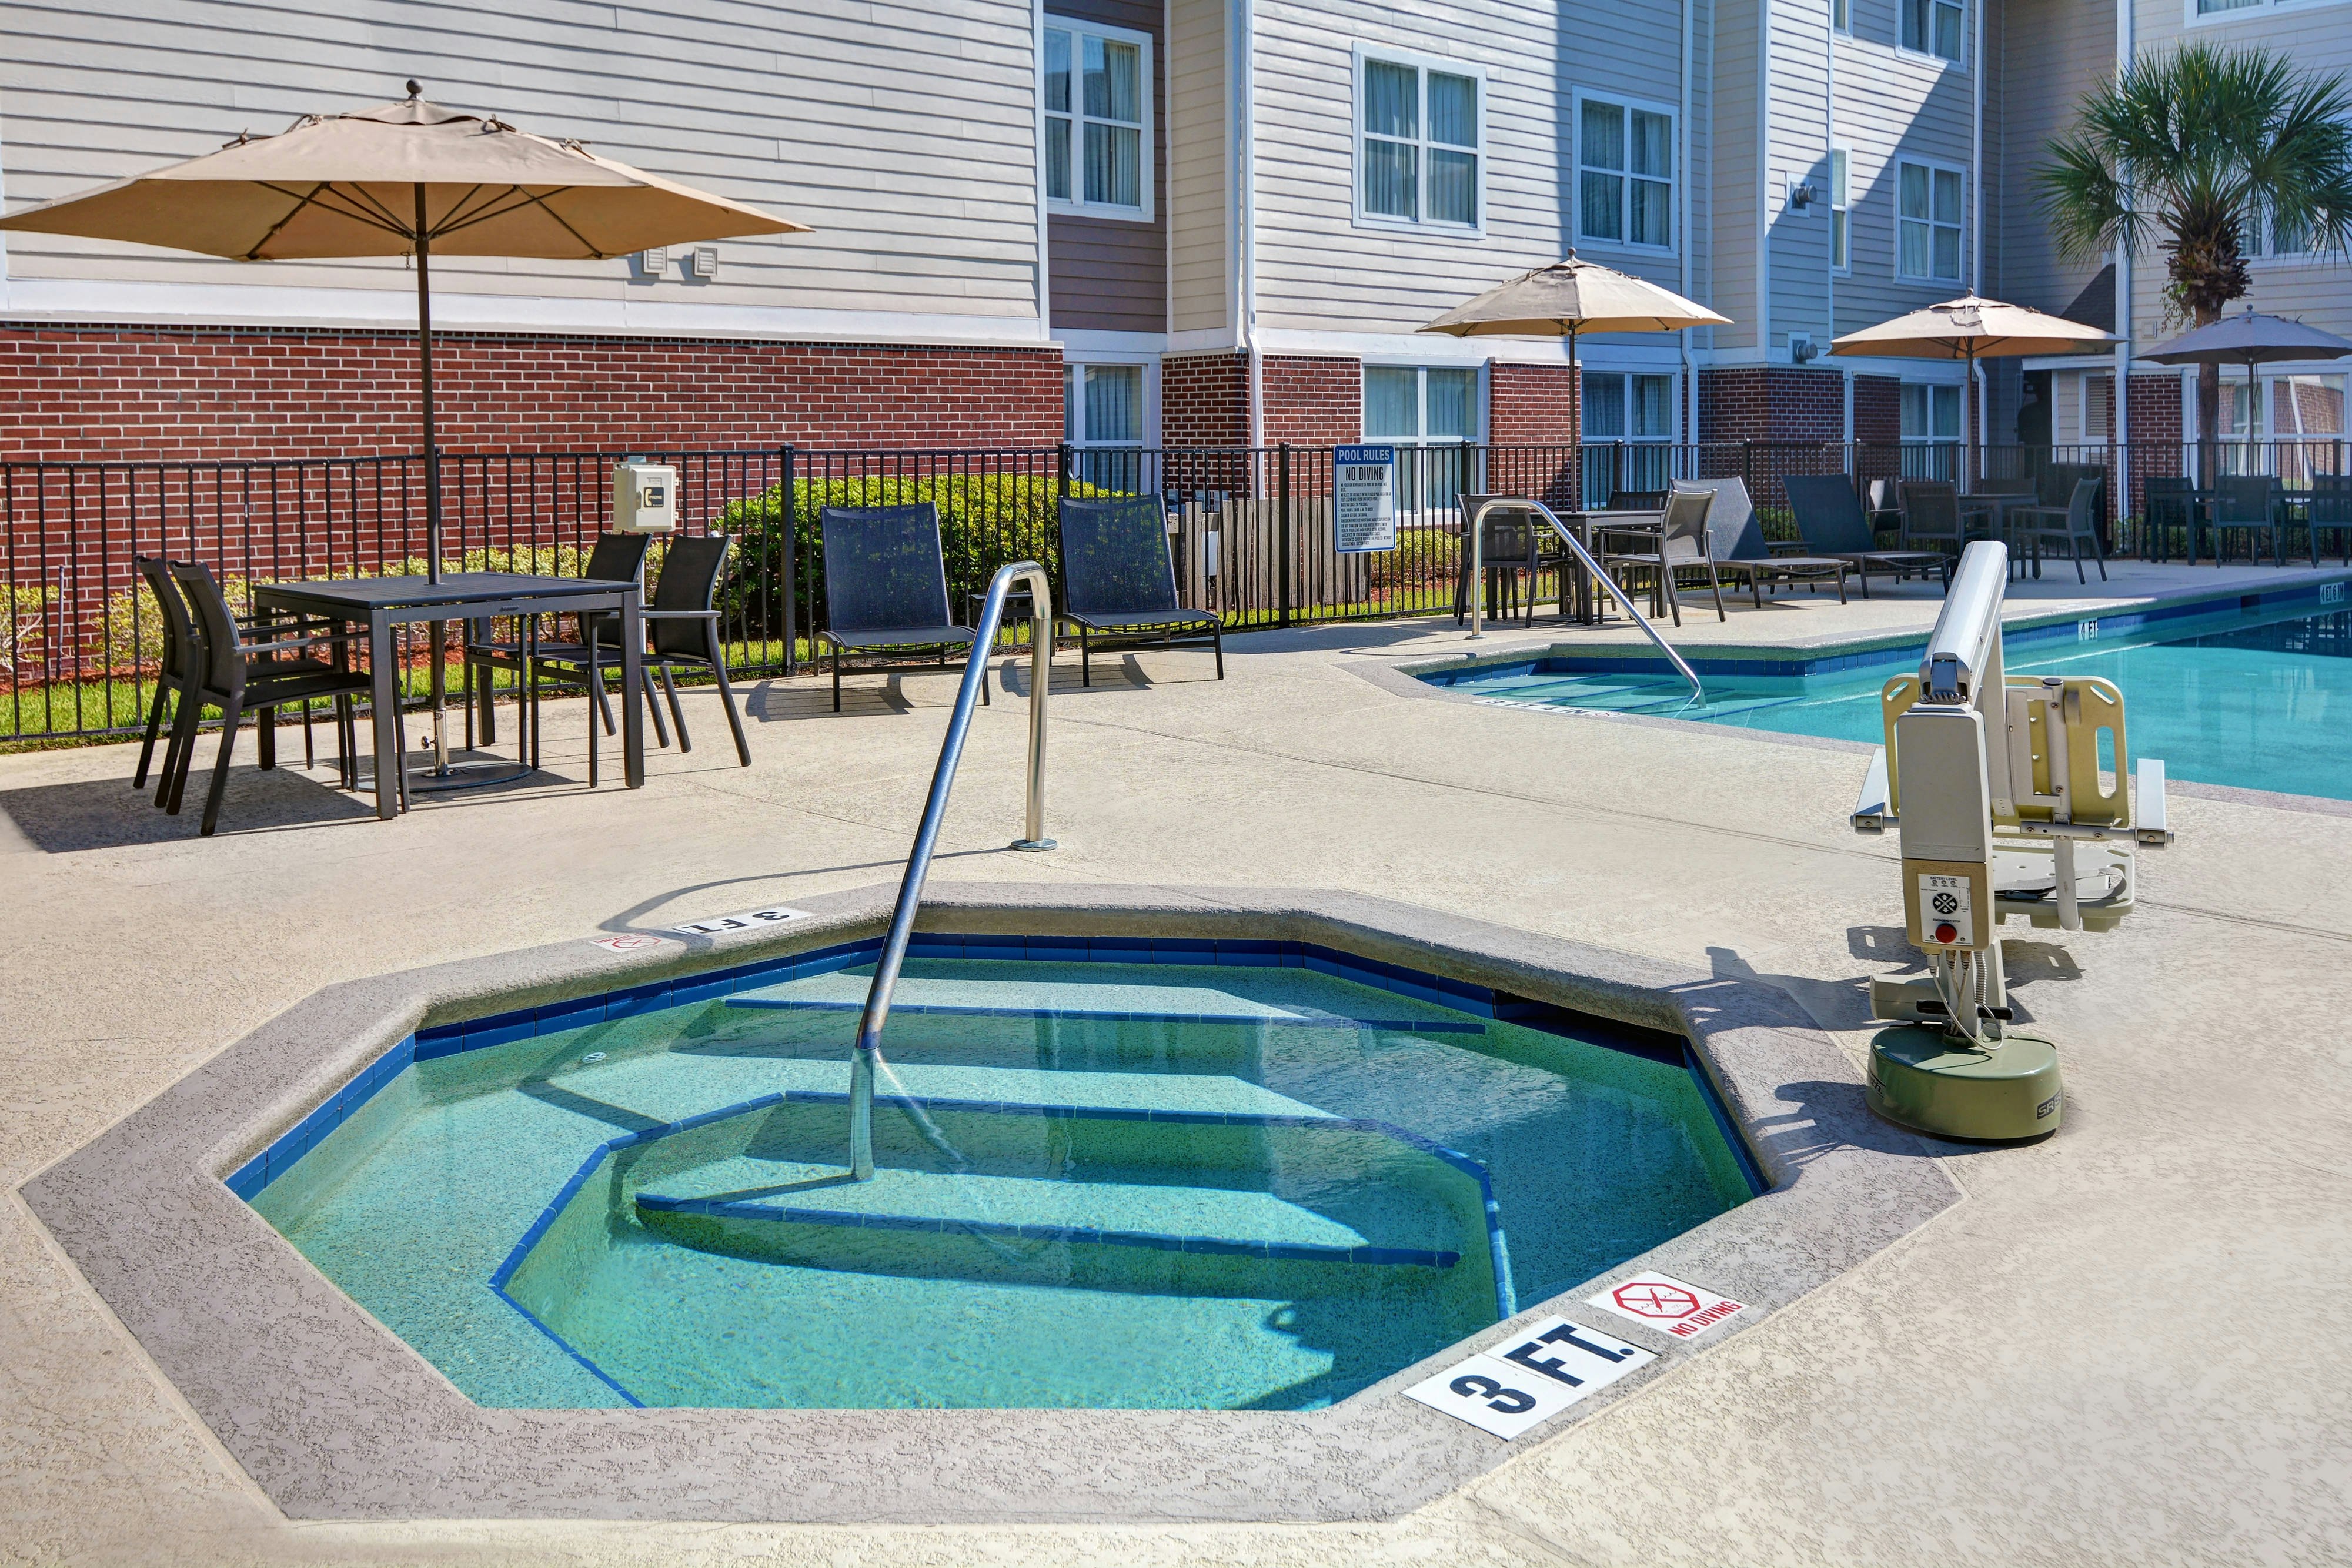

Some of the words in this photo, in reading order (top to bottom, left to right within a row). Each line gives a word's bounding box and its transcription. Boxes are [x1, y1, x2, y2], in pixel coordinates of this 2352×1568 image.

[1339, 449, 1361, 461] POOL
[1364, 449, 1390, 461] RULES
[1346, 466, 1355, 481] NO
[1359, 466, 1384, 480] DIVING
[2089, 620, 2097, 632] FT
[753, 912, 789, 920] 3
[683, 918, 749, 934] FT.
[1667, 1323, 1698, 1337] NO
[1688, 1301, 1743, 1326] DIVING
[1449, 1375, 1536, 1414] 3
[1503, 1323, 1635, 1388] FT.
